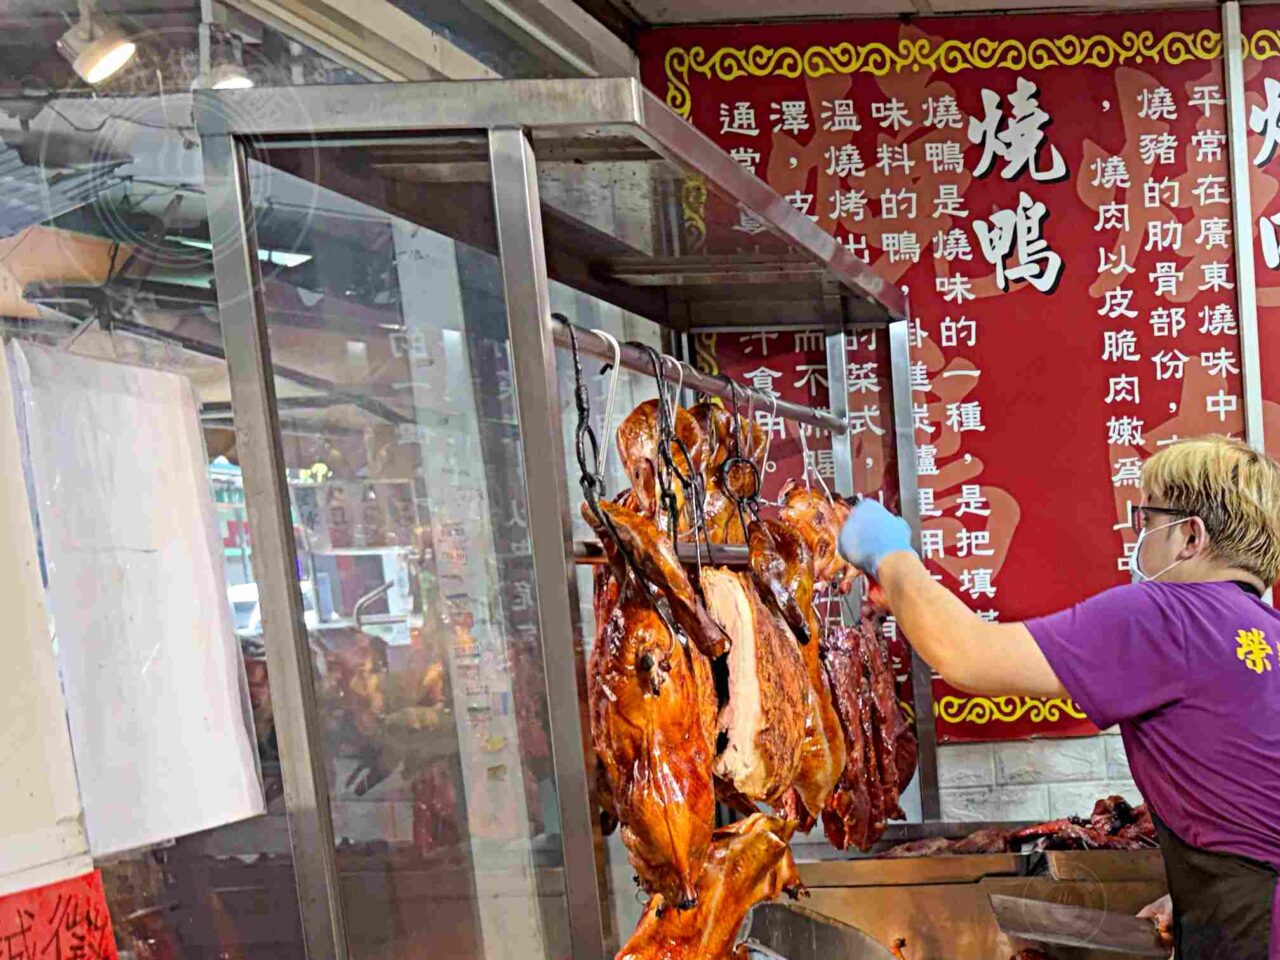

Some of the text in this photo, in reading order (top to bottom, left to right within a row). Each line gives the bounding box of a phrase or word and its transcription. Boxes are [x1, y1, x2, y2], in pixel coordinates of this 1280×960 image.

[966, 76, 1067, 293] 燒鴨
[1136, 86, 1190, 446] 燒豬的肋骨部份，
[1188, 85, 1243, 442] 平常在廣東燒味中
